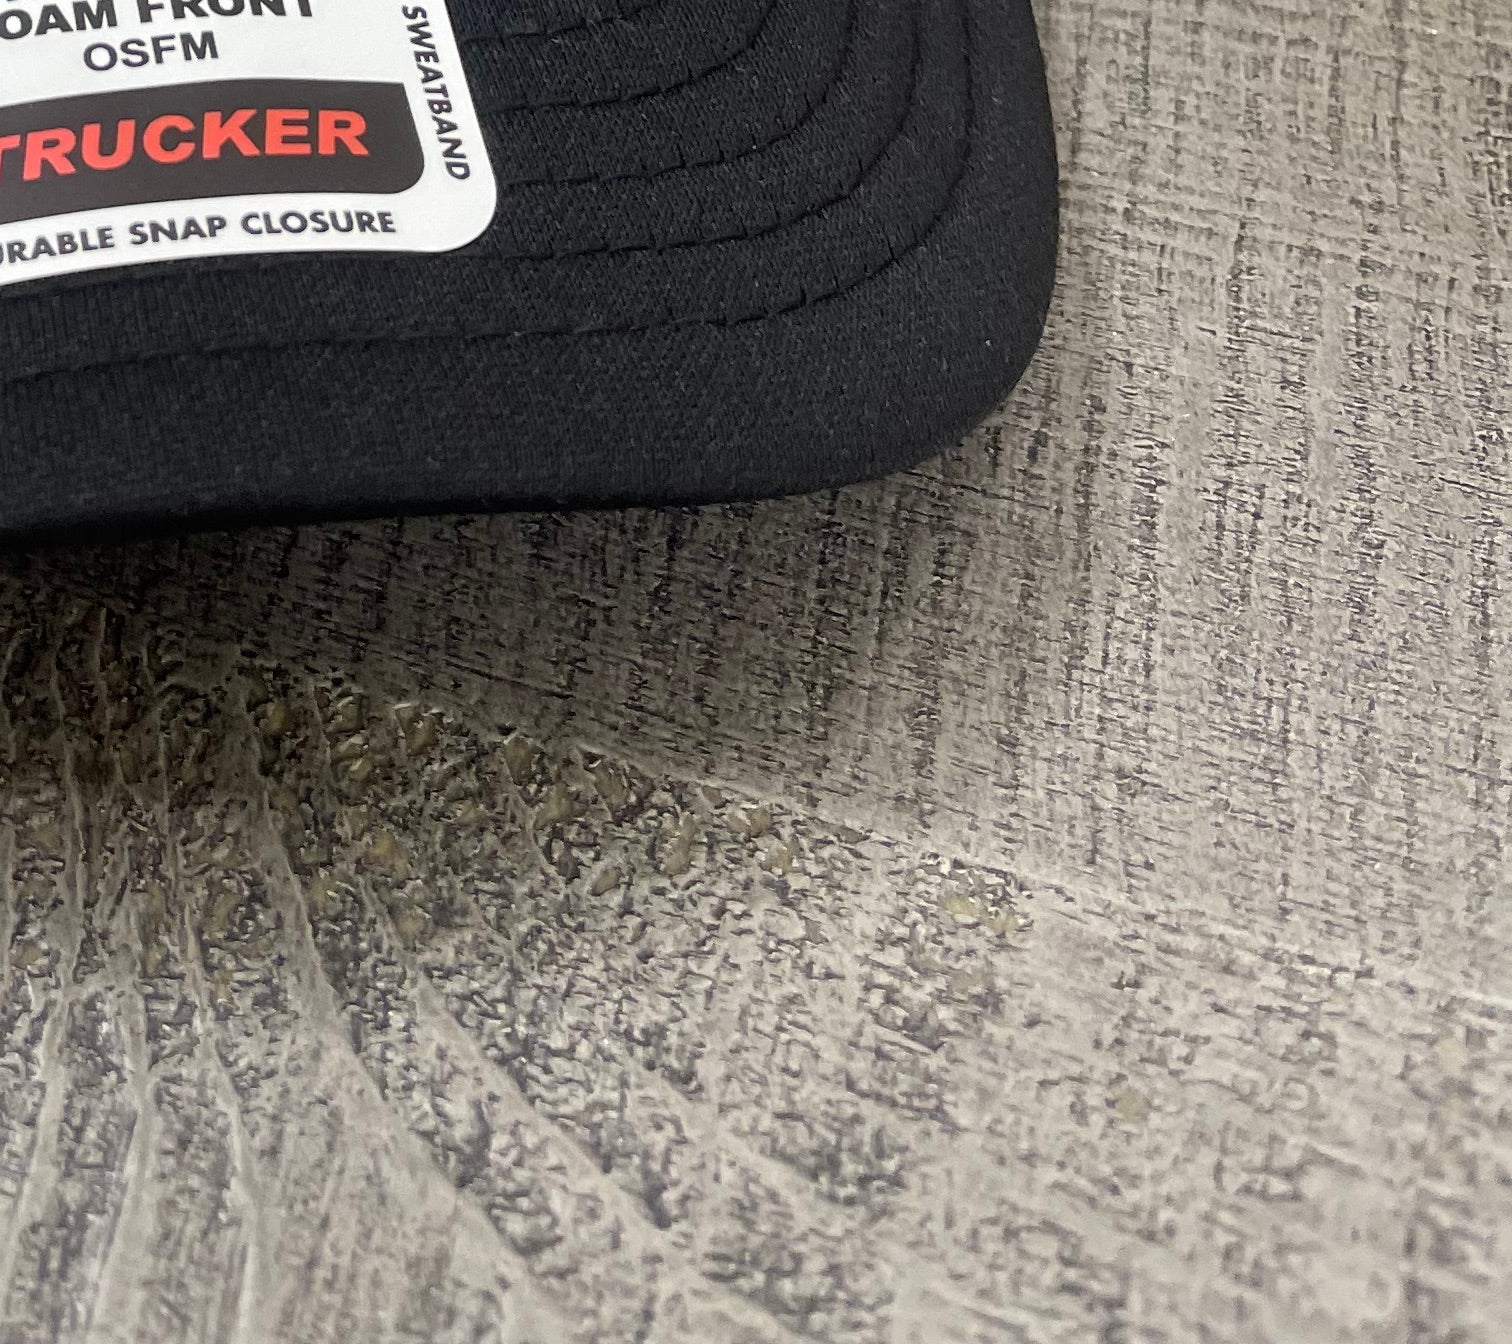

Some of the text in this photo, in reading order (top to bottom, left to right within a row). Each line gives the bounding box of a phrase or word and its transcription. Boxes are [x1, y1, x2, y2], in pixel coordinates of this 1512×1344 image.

[83, 32, 219, 71] OSFM
[402, 6, 471, 181] SWEATBAND
[129, 216, 227, 246] SNAP
[241, 211, 396, 237] CLOSURE
